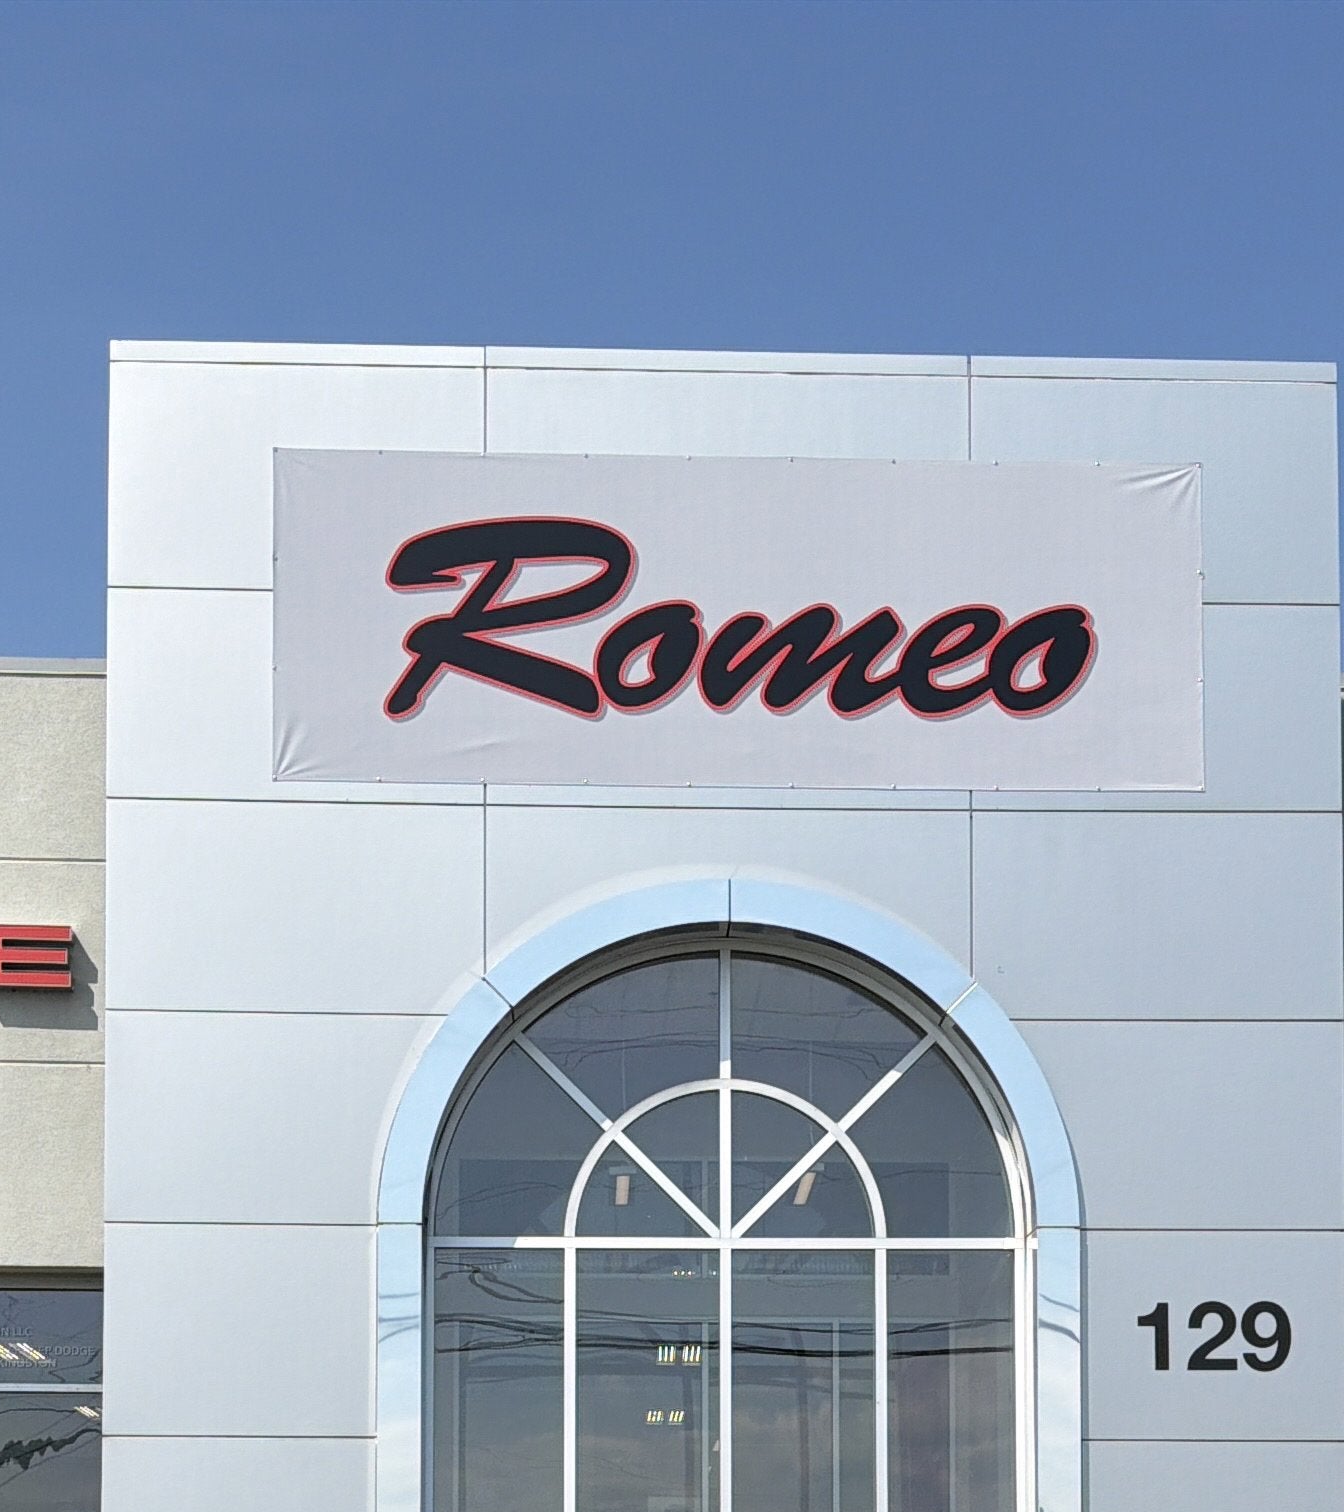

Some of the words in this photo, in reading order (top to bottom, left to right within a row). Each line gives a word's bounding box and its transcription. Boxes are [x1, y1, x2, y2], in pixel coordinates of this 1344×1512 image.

[384, 516, 1097, 720] Romeo
[12, 1327, 33, 1337] LLC
[54, 1346, 96, 1356] DODGE
[1136, 1301, 1292, 1372] 129
